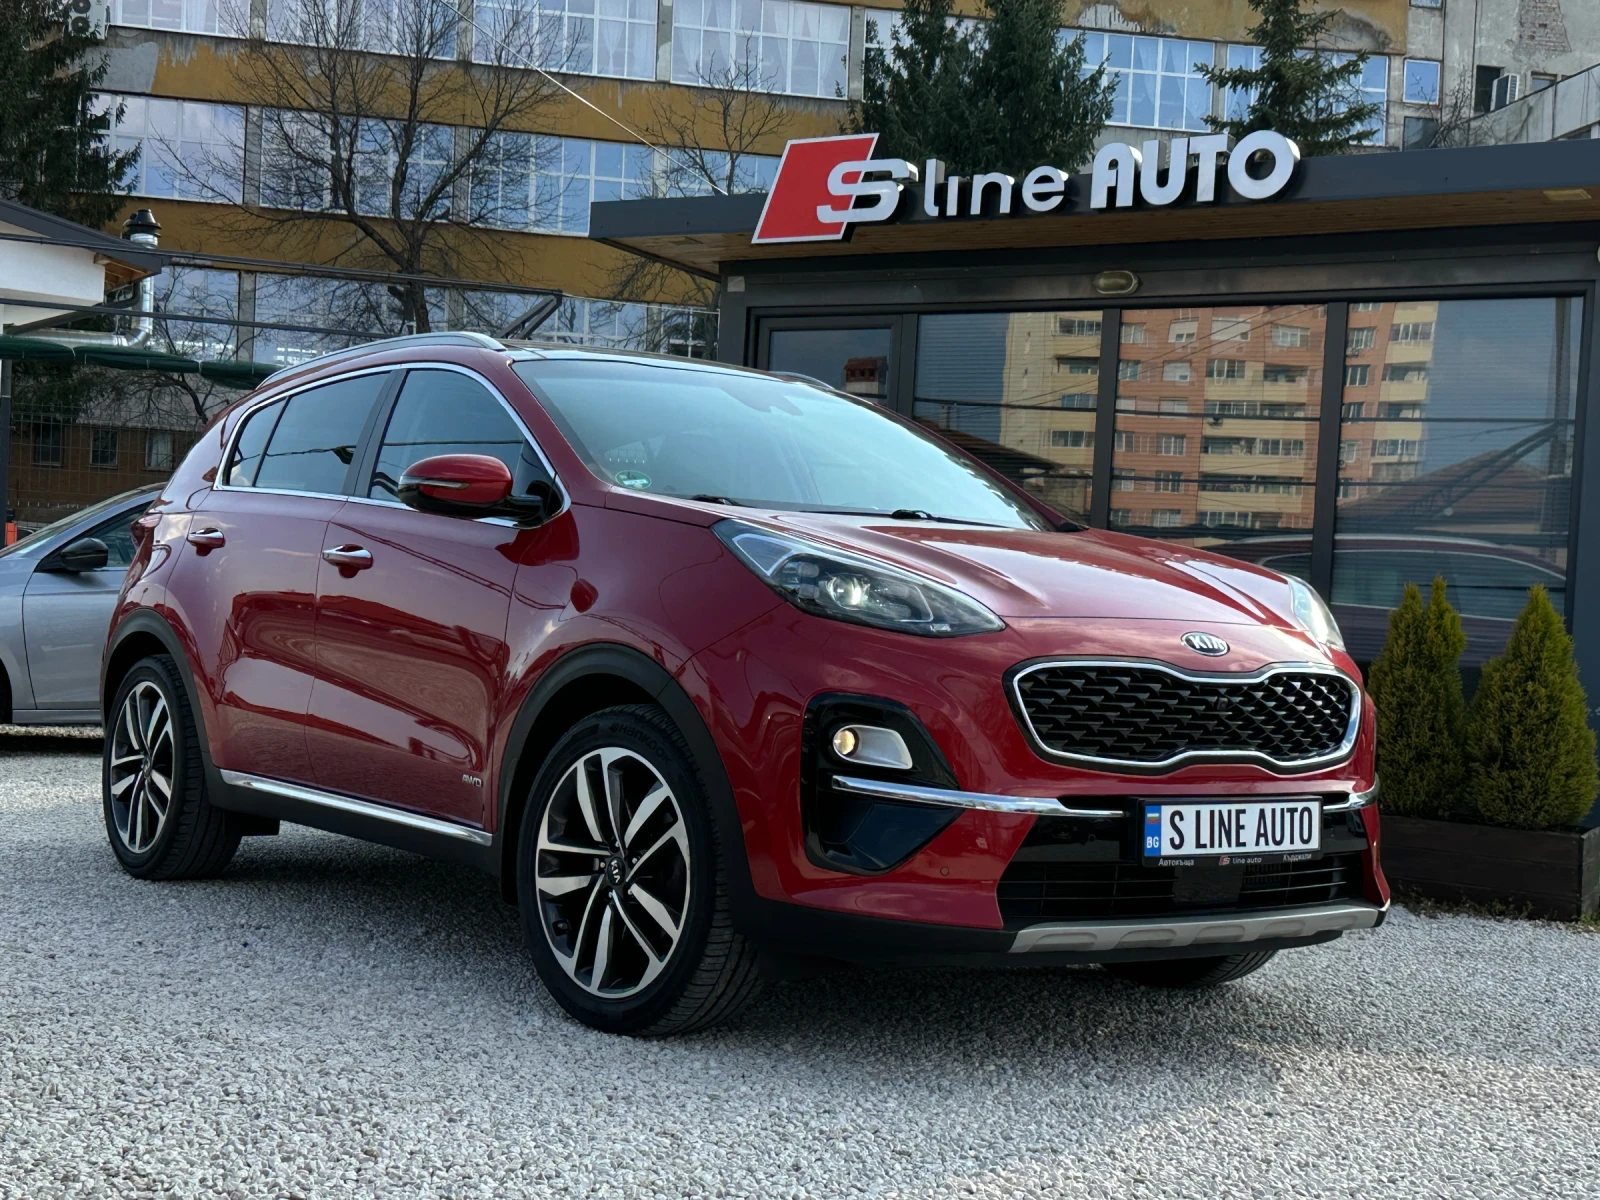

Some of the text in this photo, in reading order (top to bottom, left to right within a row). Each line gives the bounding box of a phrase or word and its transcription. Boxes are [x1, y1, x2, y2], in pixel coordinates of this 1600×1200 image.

[816, 129, 1300, 224] S line AUTO
[462, 774, 482, 788] AWD
[1169, 806, 1313, 851] S LINE AUTO
[1146, 836, 1160, 849] BG
[1158, 858, 1194, 867] Автокъща
